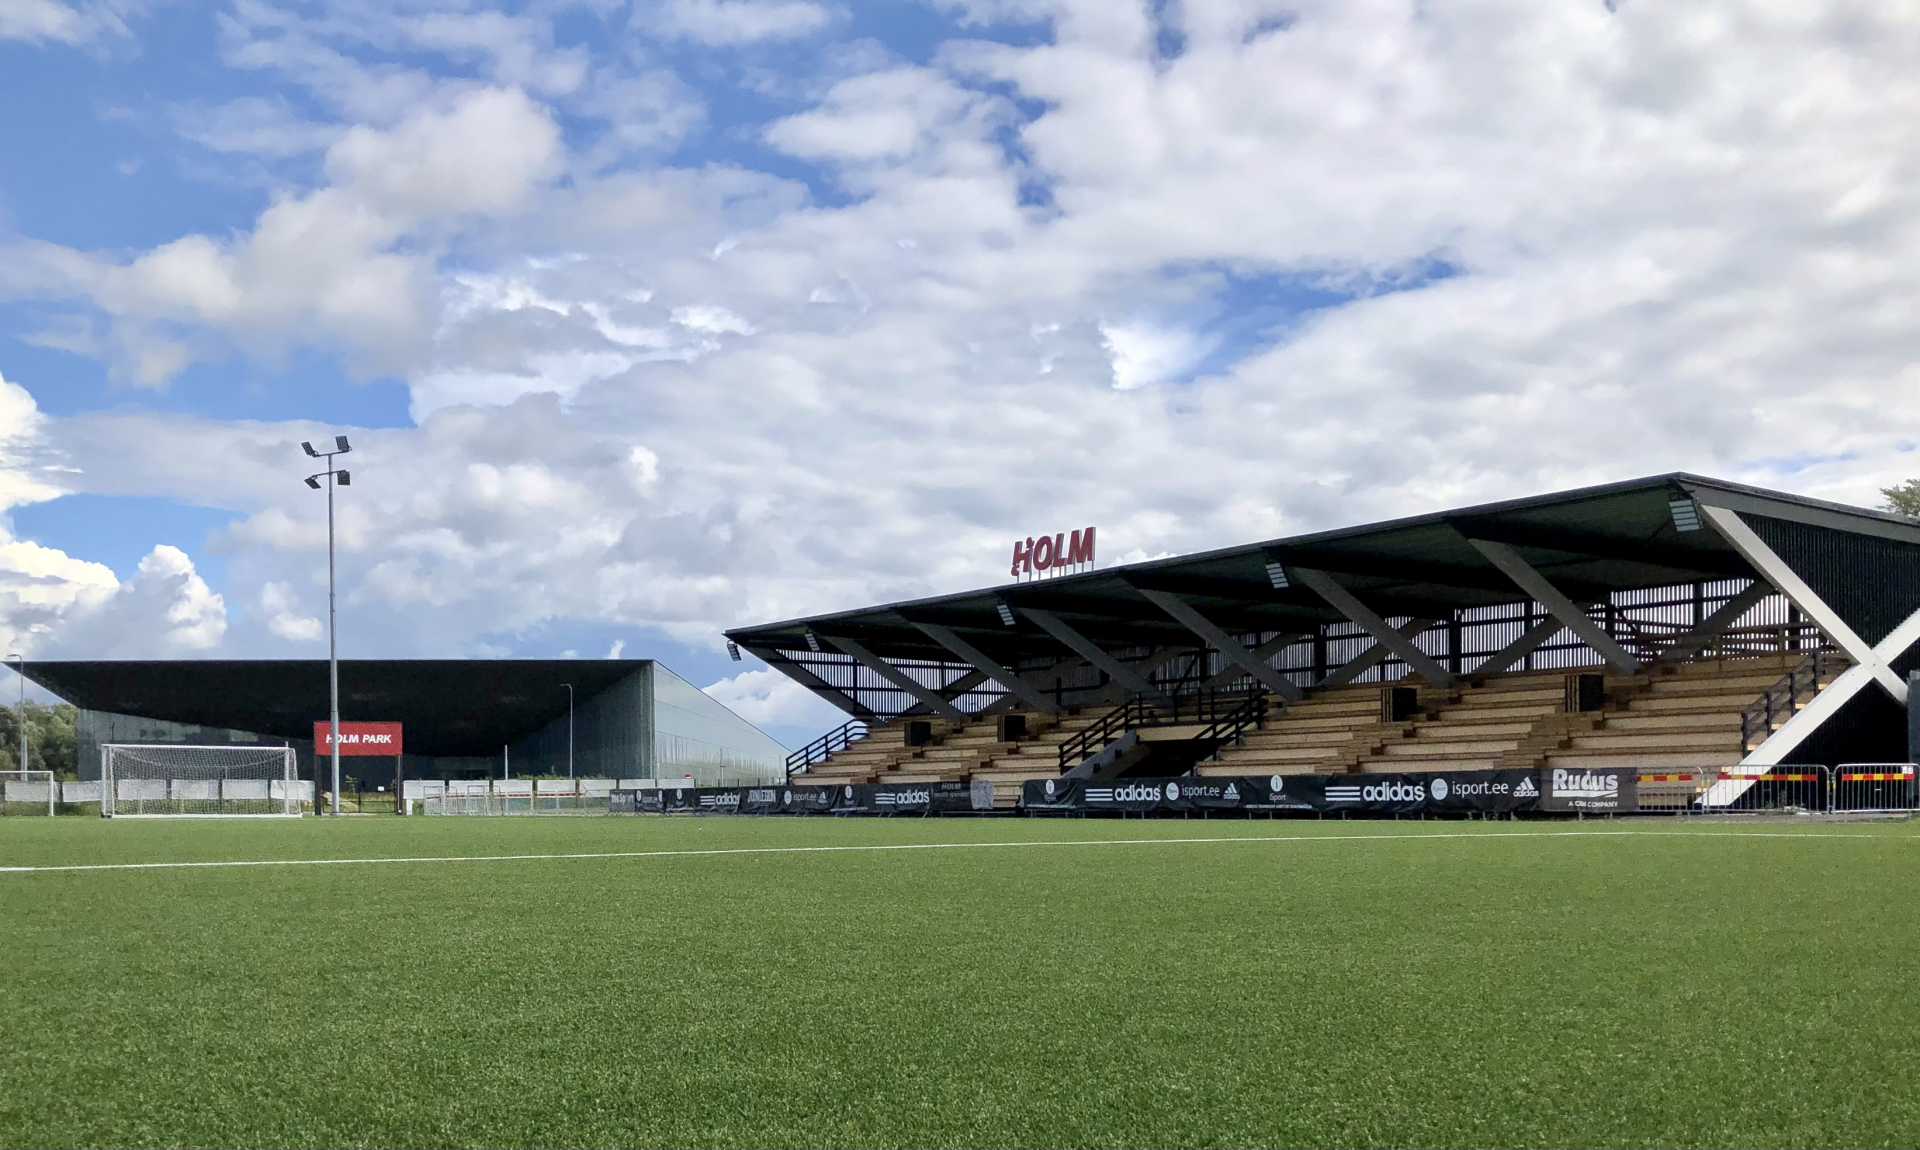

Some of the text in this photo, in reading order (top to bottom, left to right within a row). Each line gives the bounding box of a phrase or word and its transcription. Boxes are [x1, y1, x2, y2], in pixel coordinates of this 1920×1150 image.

[1011, 526, 1096, 576] HOLM
[362, 734, 392, 744] PARK
[1553, 768, 1619, 791] Rudus
[793, 791, 817, 803] isport.ee
[897, 789, 930, 805] adidas
[1115, 784, 1162, 802] adidas
[1181, 784, 1220, 799] isport.ee
[1363, 781, 1425, 802] adidas
[1452, 781, 1509, 798] isport.ee
[1513, 789, 1540, 797] adidas
[715, 792, 741, 805] adidas
